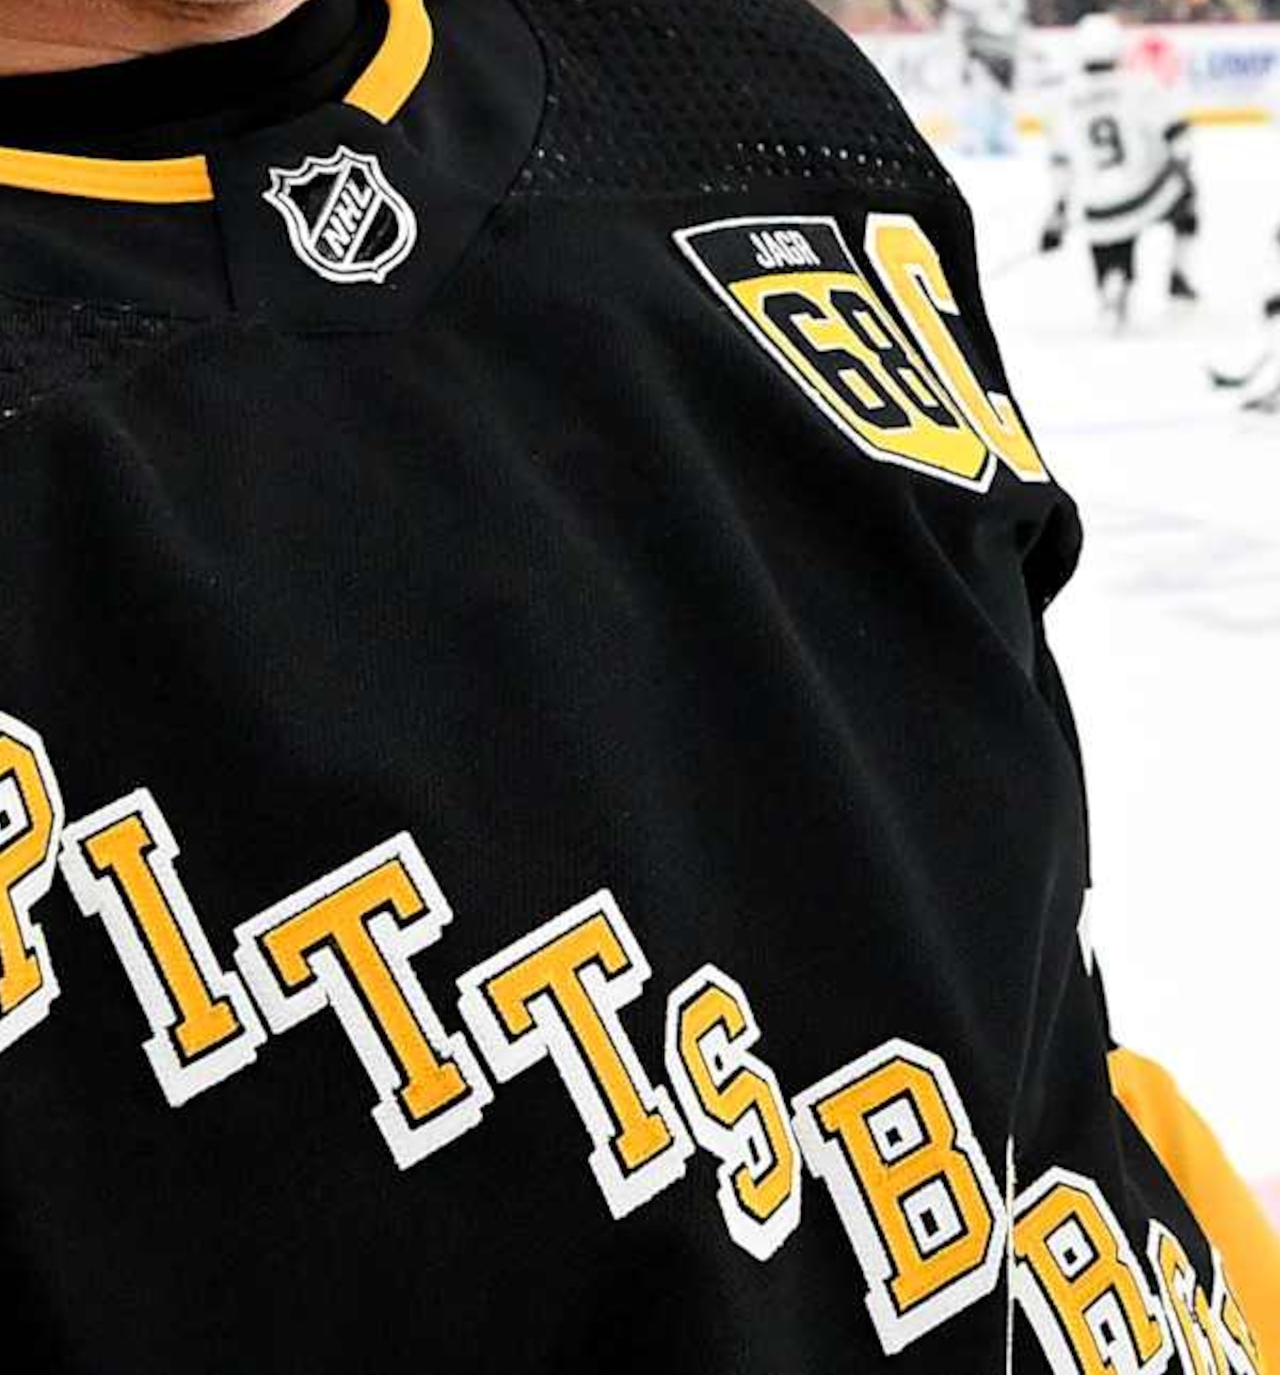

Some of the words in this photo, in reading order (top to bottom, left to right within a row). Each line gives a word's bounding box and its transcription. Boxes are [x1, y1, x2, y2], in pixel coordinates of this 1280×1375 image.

[1088, 115, 1126, 170] 9
[321, 179, 373, 259] NHL
[750, 230, 821, 269] JAGR
[762, 287, 961, 430] 68
[863, 212, 1050, 483] C
